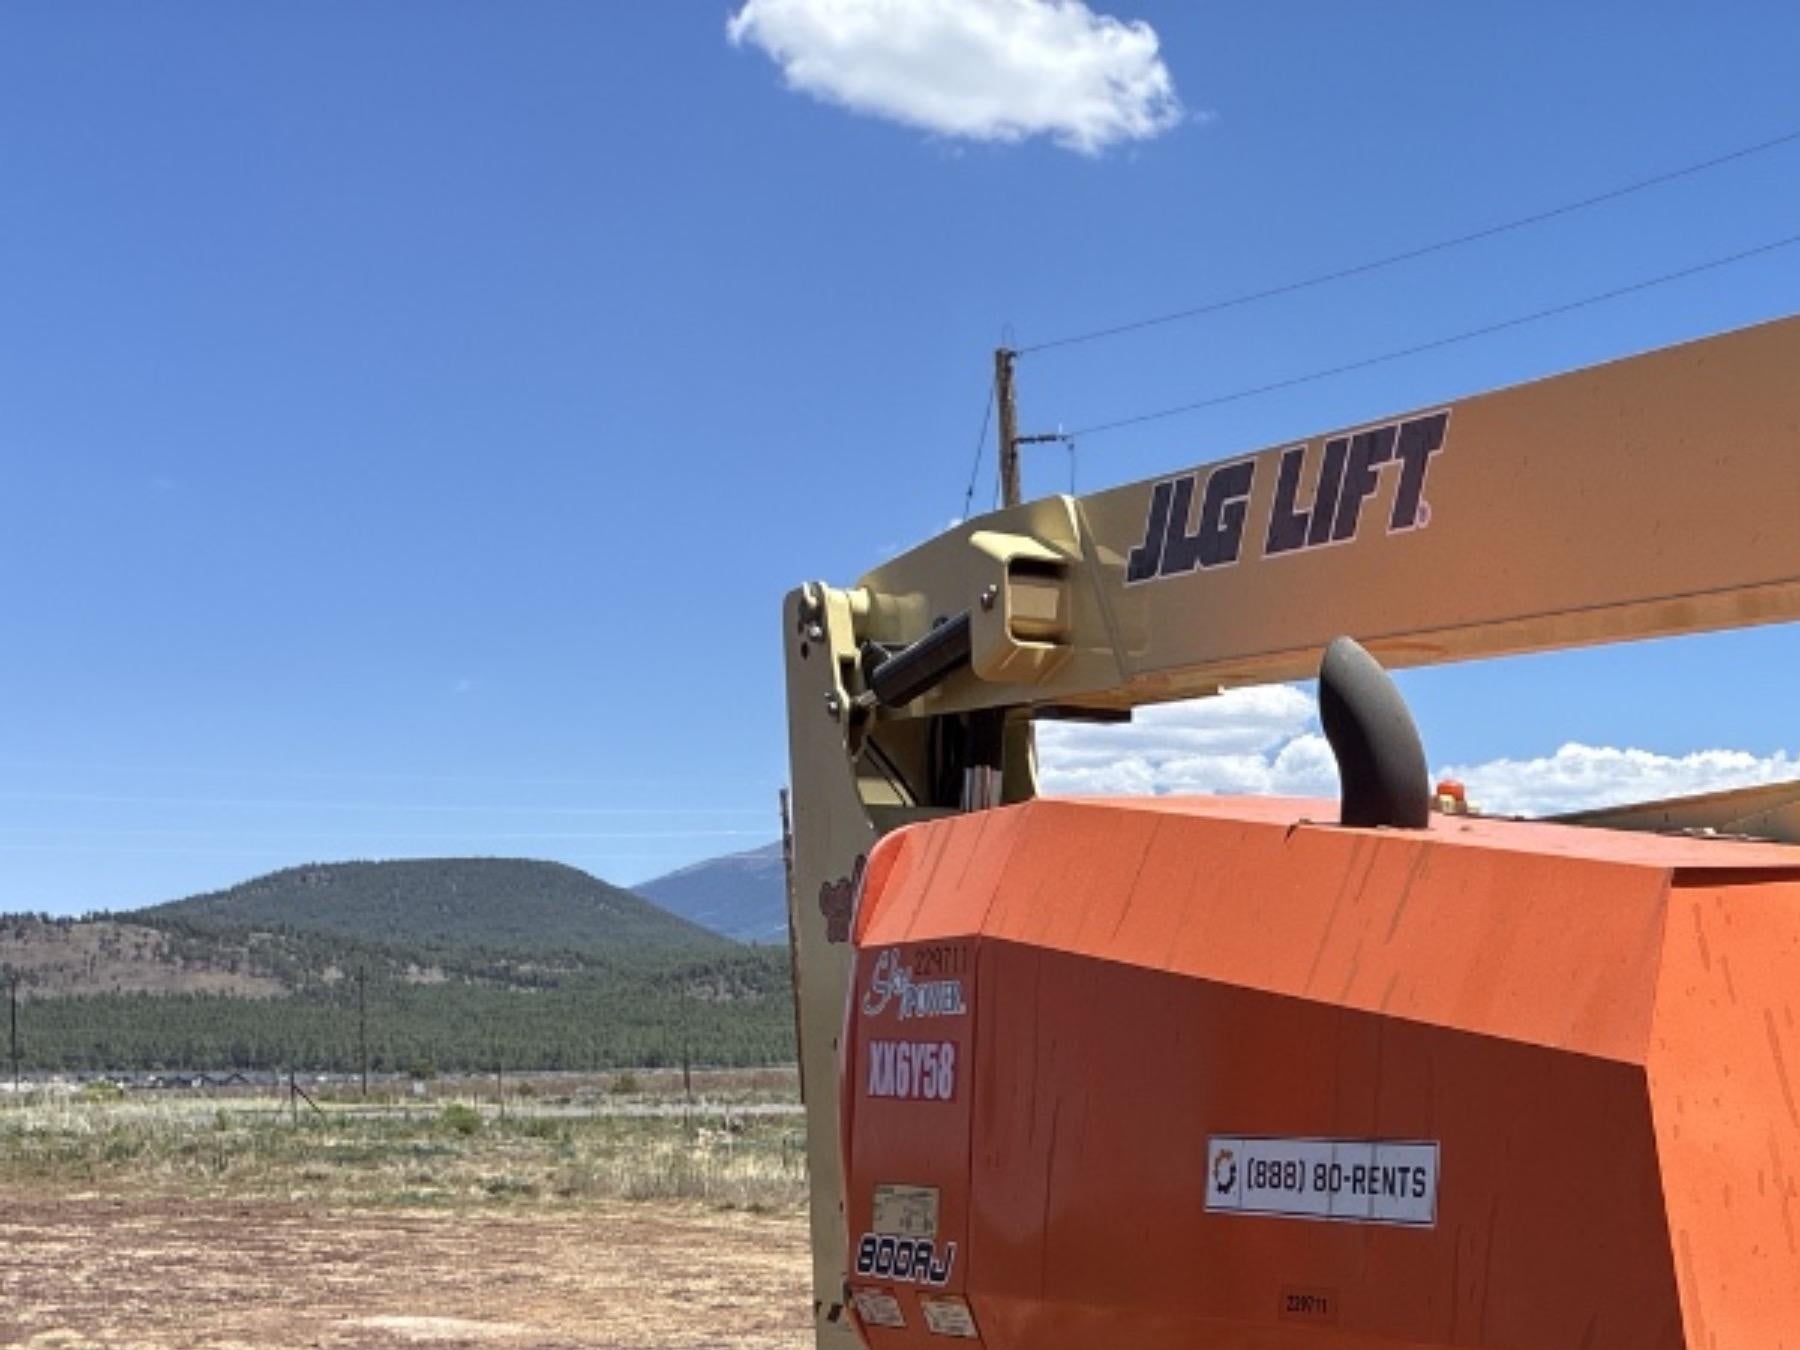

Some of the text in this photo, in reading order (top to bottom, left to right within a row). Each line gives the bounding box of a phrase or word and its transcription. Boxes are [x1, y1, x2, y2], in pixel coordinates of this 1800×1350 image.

[1124, 408, 1453, 588] JLG LIFT
[1247, 1157, 1427, 1198] (888) 80-RENTS
[855, 1233, 959, 1287] 800AJ
